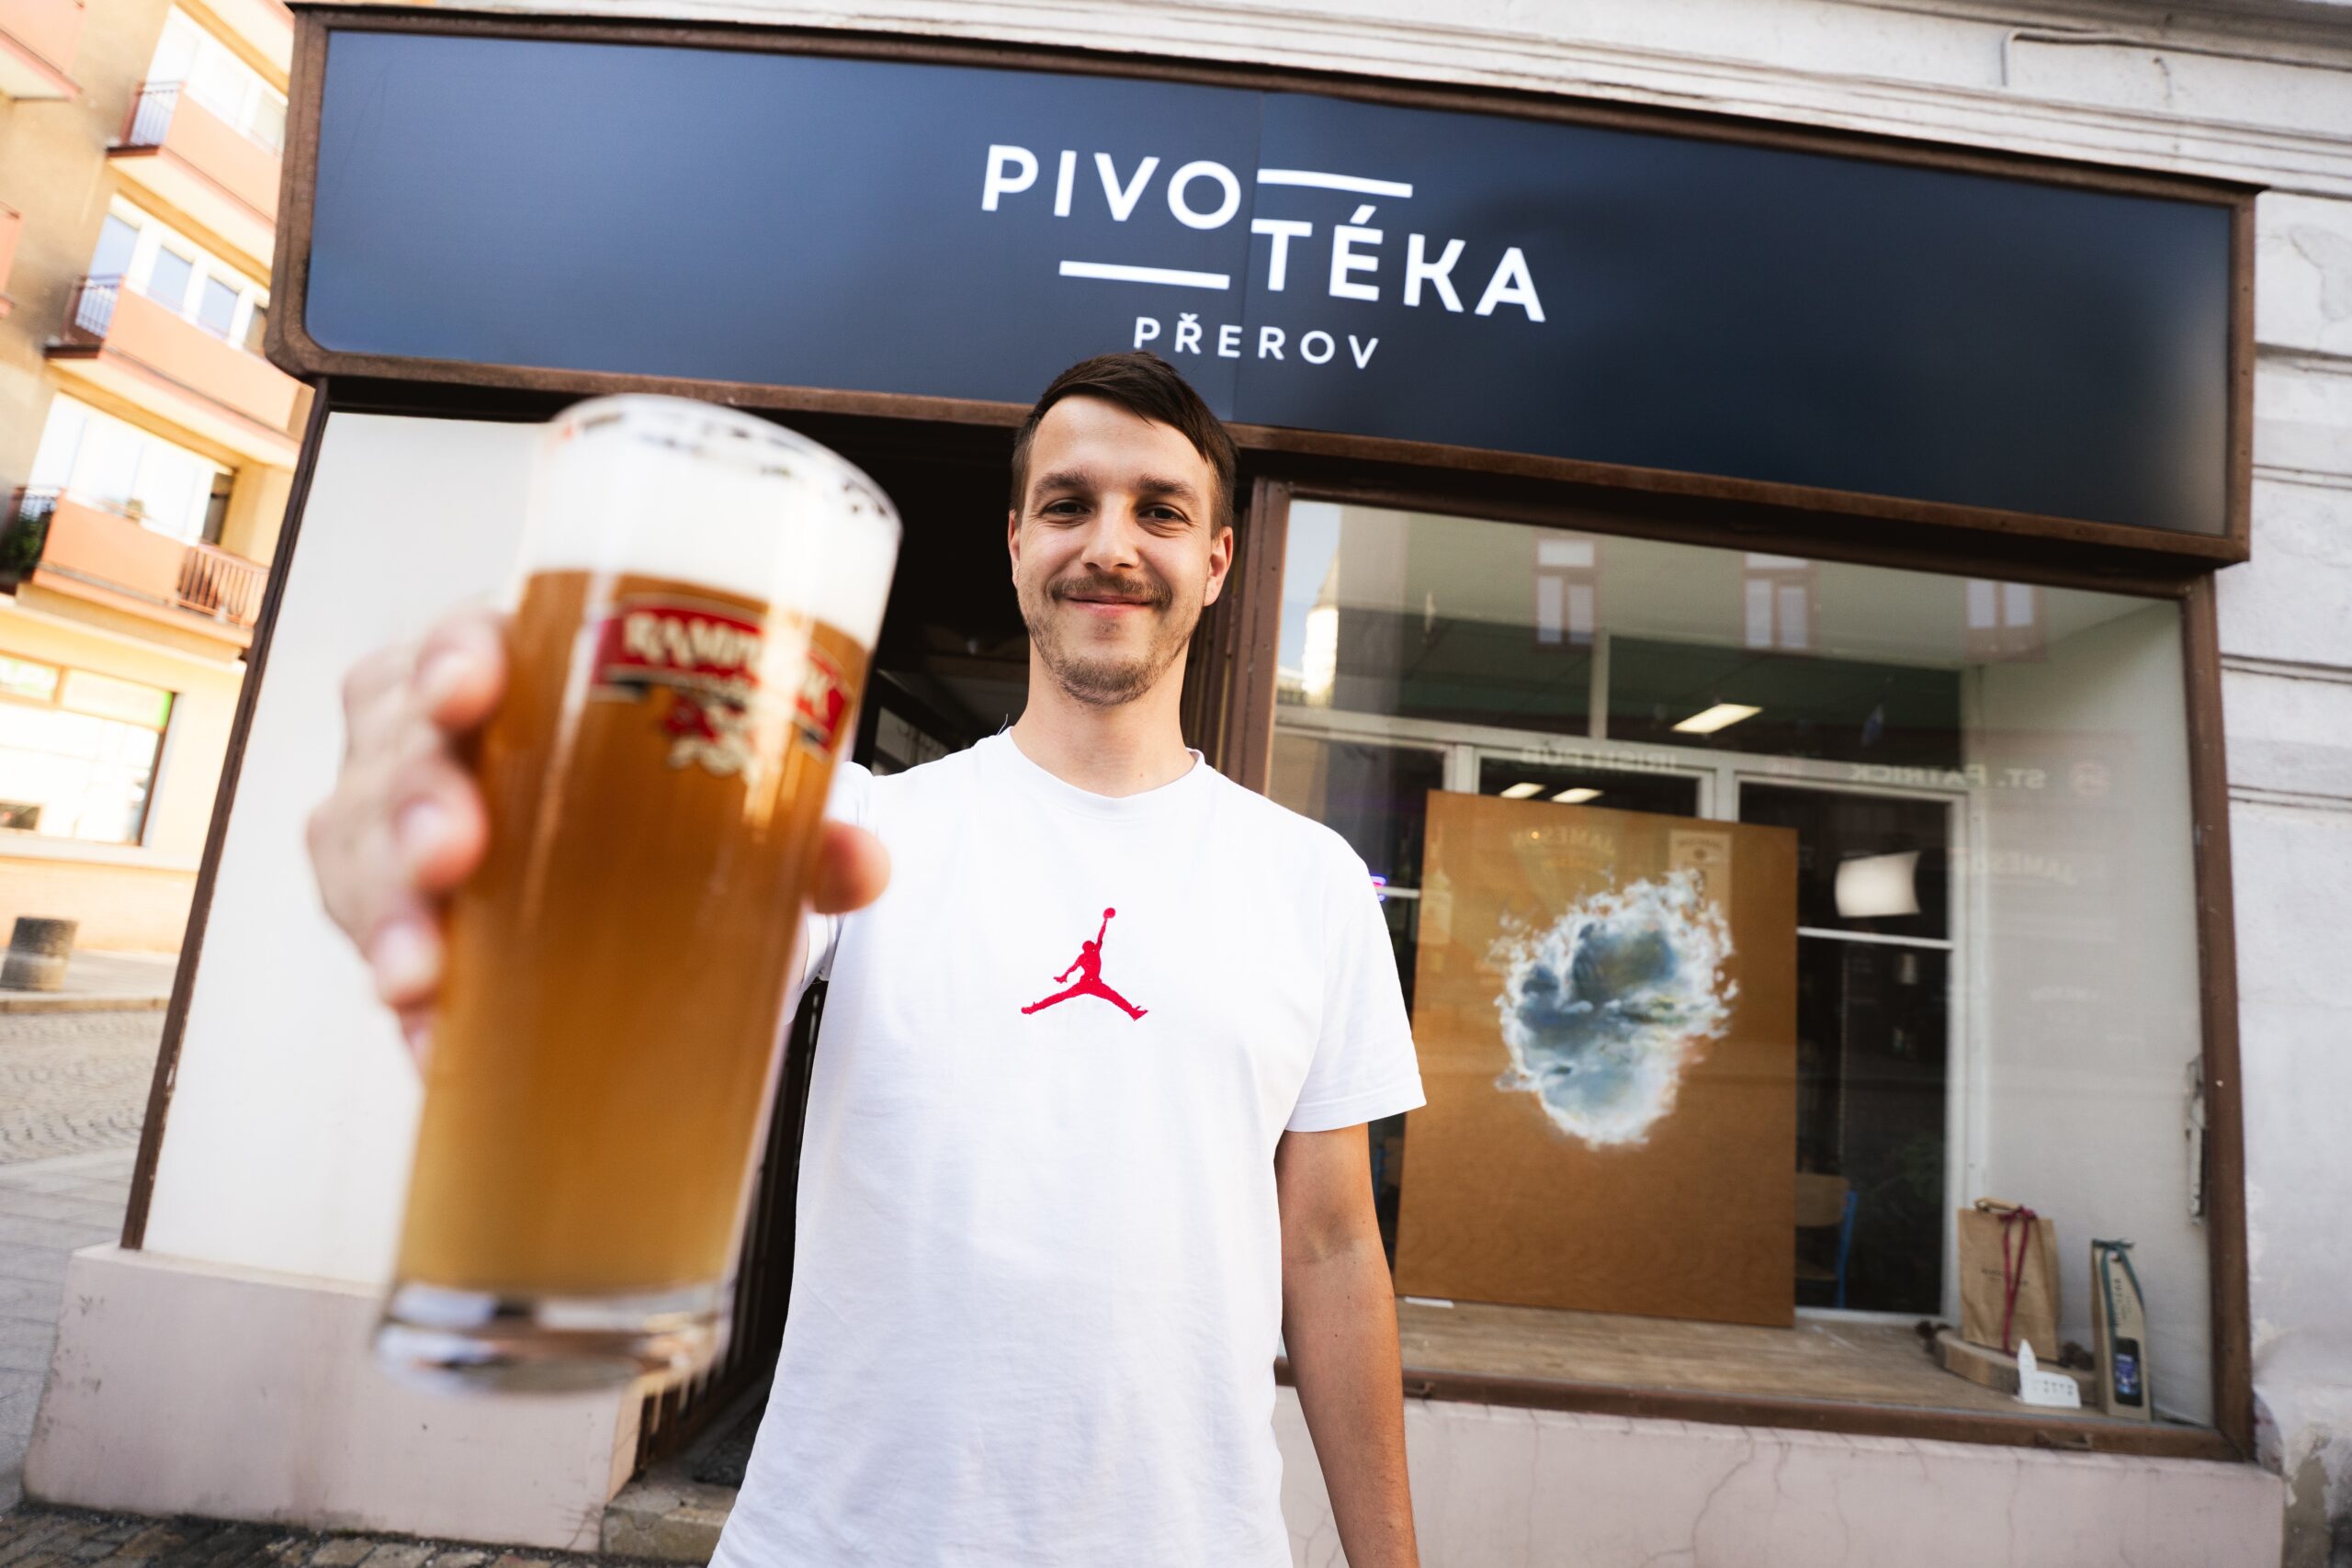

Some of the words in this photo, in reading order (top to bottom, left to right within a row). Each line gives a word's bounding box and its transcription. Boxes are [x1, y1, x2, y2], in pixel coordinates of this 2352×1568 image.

[981, 143, 1241, 231] PIVO
[1250, 204, 1545, 322] TÉKA
[1133, 312, 1379, 369] PŘEROV
